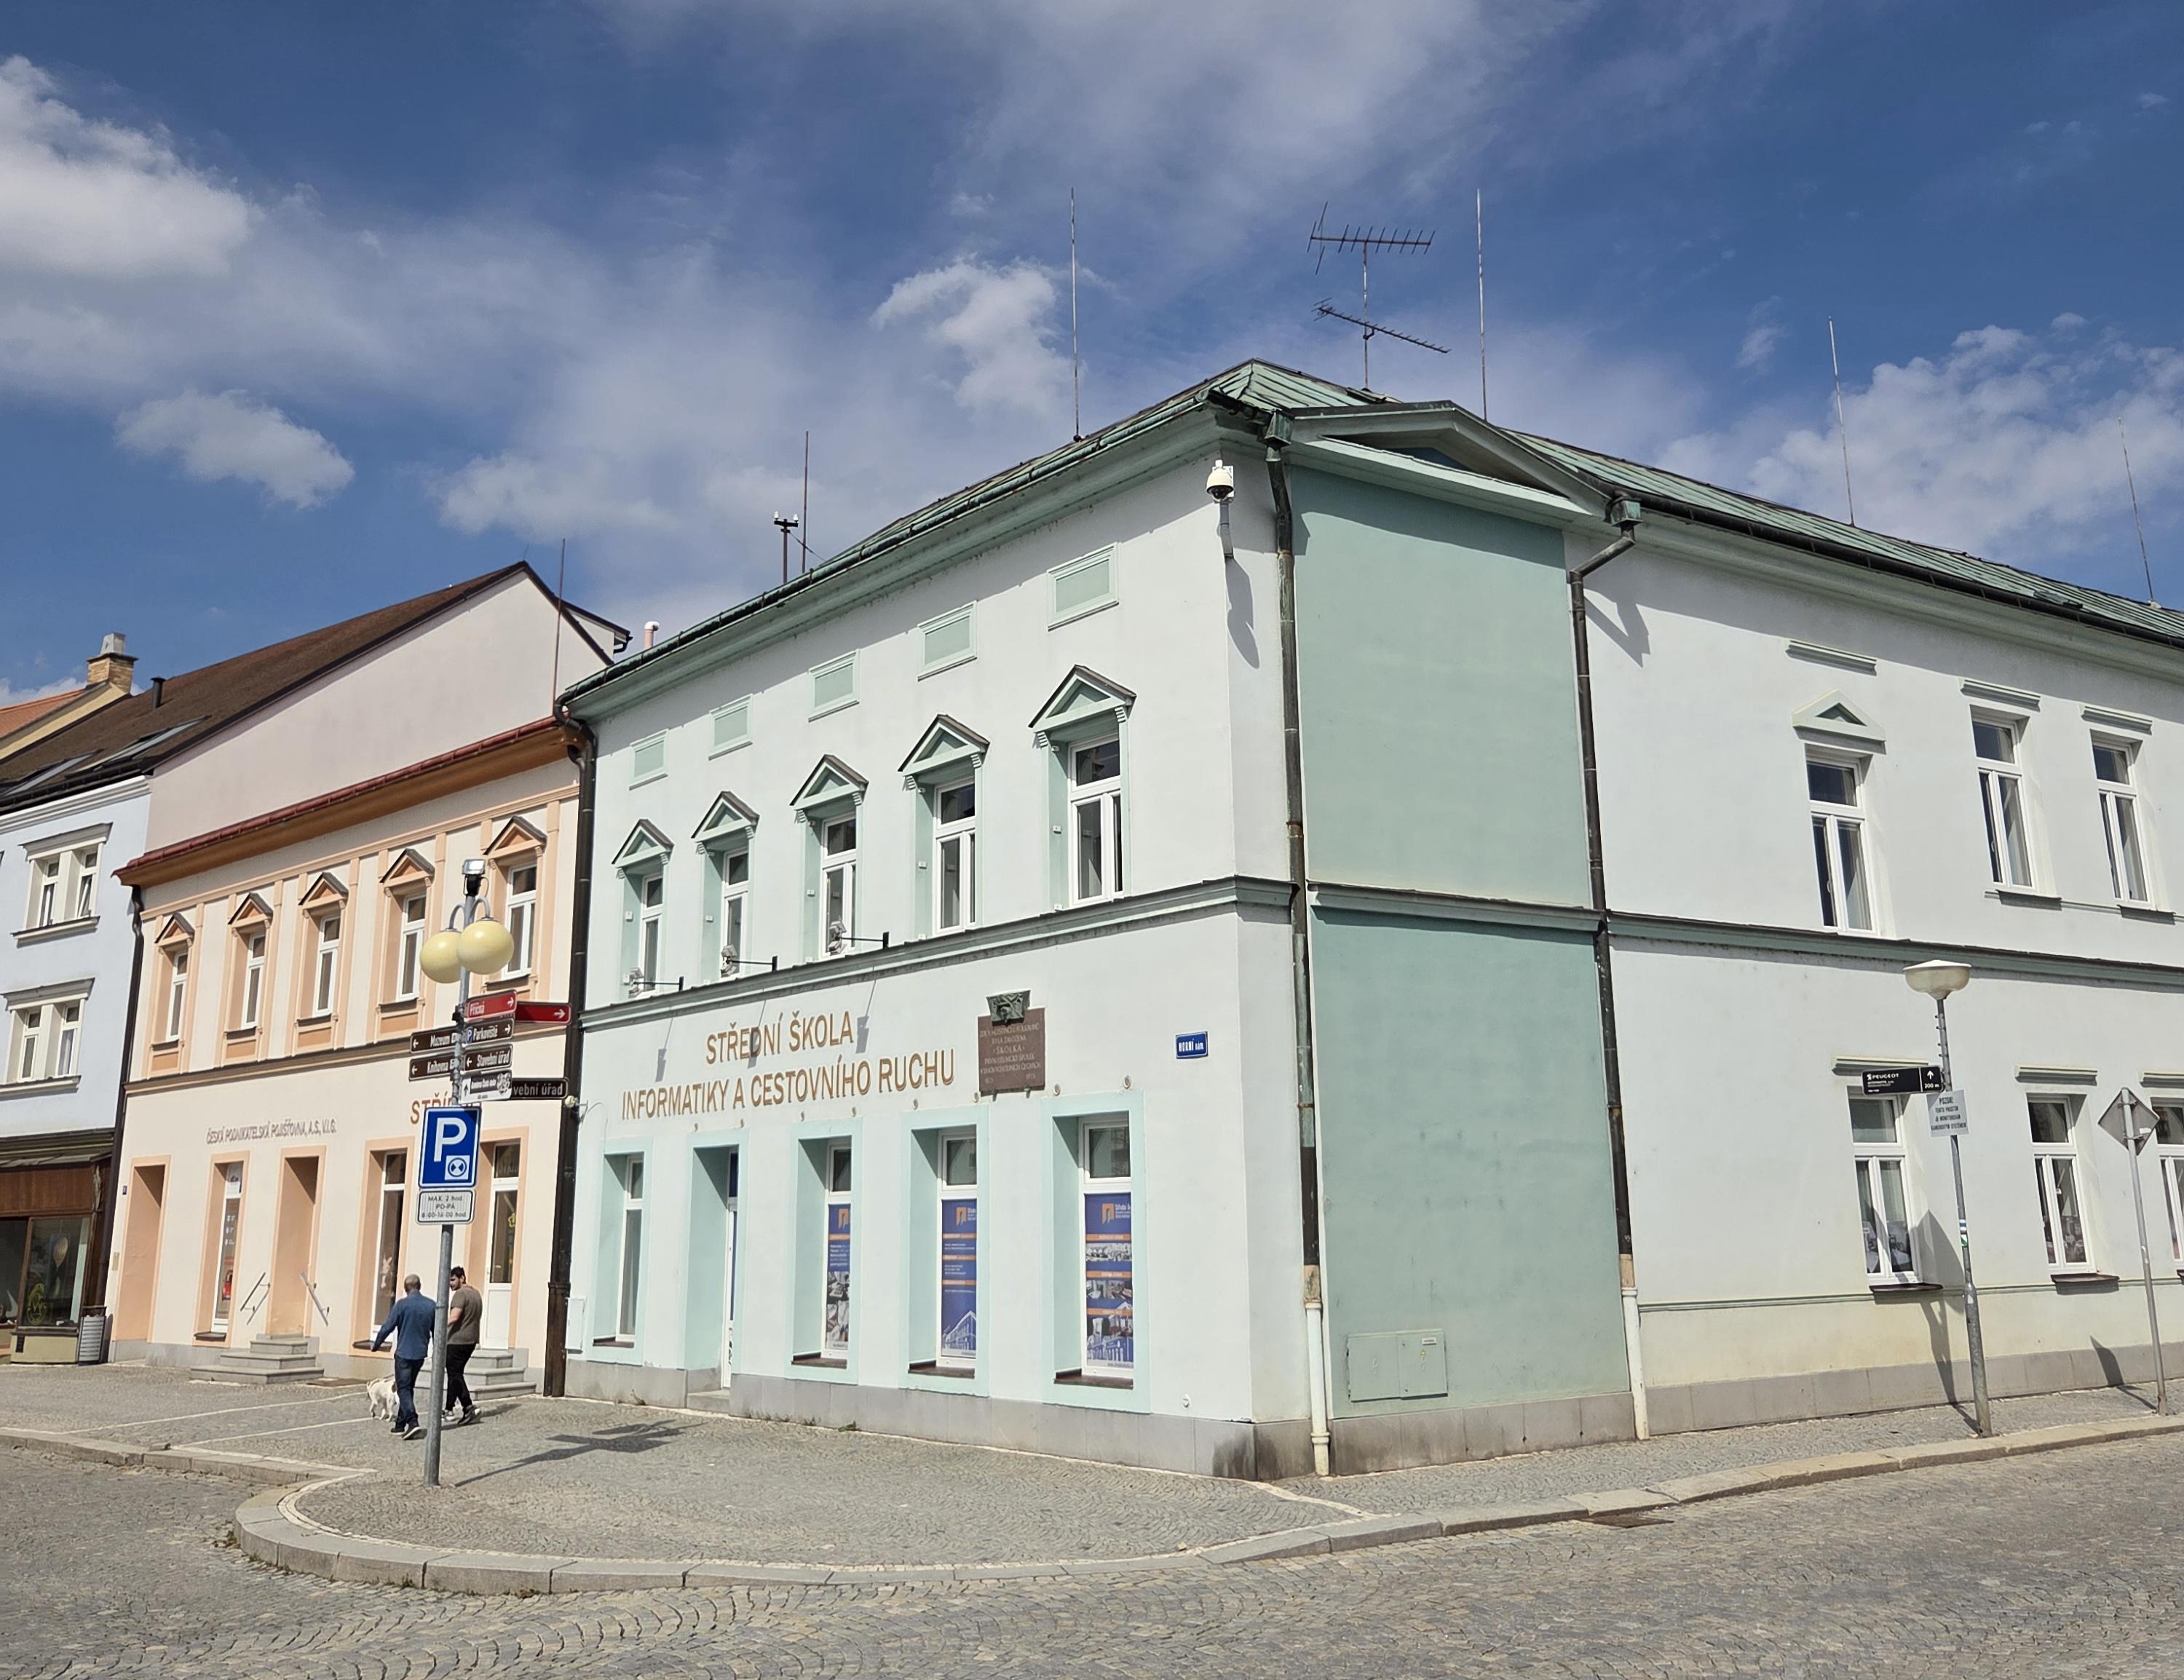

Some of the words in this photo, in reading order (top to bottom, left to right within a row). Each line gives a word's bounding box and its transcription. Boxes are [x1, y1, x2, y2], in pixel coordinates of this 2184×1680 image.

[430, 1034, 451, 1047] Muzeum
[473, 1024, 498, 1041] Parkoviště
[706, 1012, 783, 1064] STŘEDNÍ
[789, 1010, 854, 1052] ŠKOLA
[427, 1060, 448, 1074] Knihovna
[477, 1052, 498, 1067] Stavební
[498, 1050, 510, 1063] úřad
[512, 1082, 539, 1095] vební
[541, 1082, 563, 1095] úřad
[622, 1079, 729, 1120] INFORMATIKY
[733, 1077, 745, 1109] A
[751, 1054, 871, 1107] CESTOVNÍHO
[879, 1048, 954, 1093] RUCHU
[433, 1117, 467, 1162] P
